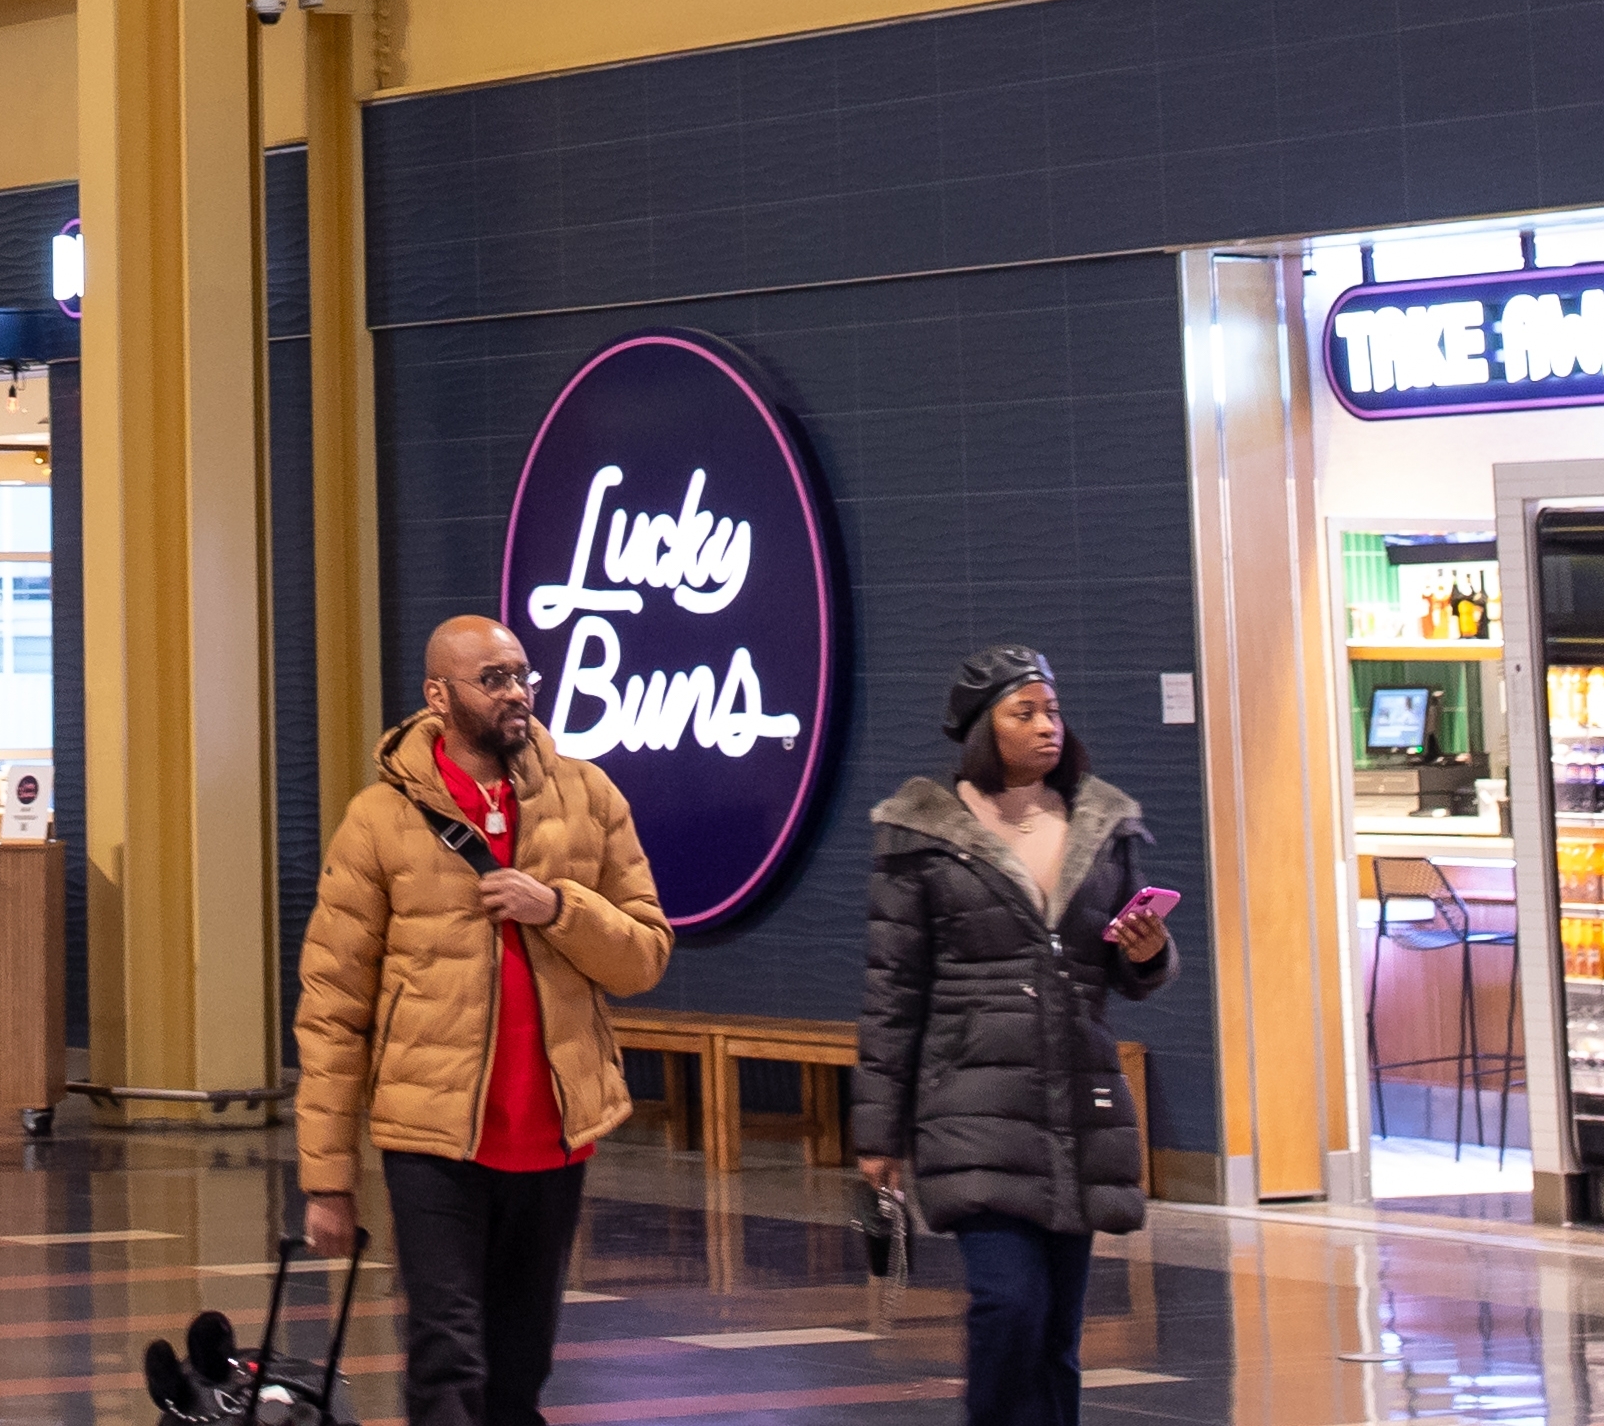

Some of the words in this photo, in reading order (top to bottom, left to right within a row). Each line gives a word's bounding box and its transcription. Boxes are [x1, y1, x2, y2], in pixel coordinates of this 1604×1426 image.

[1335, 300, 1489, 393] TAKE
[528, 465, 751, 630] Lucky
[550, 615, 801, 760] Buns
